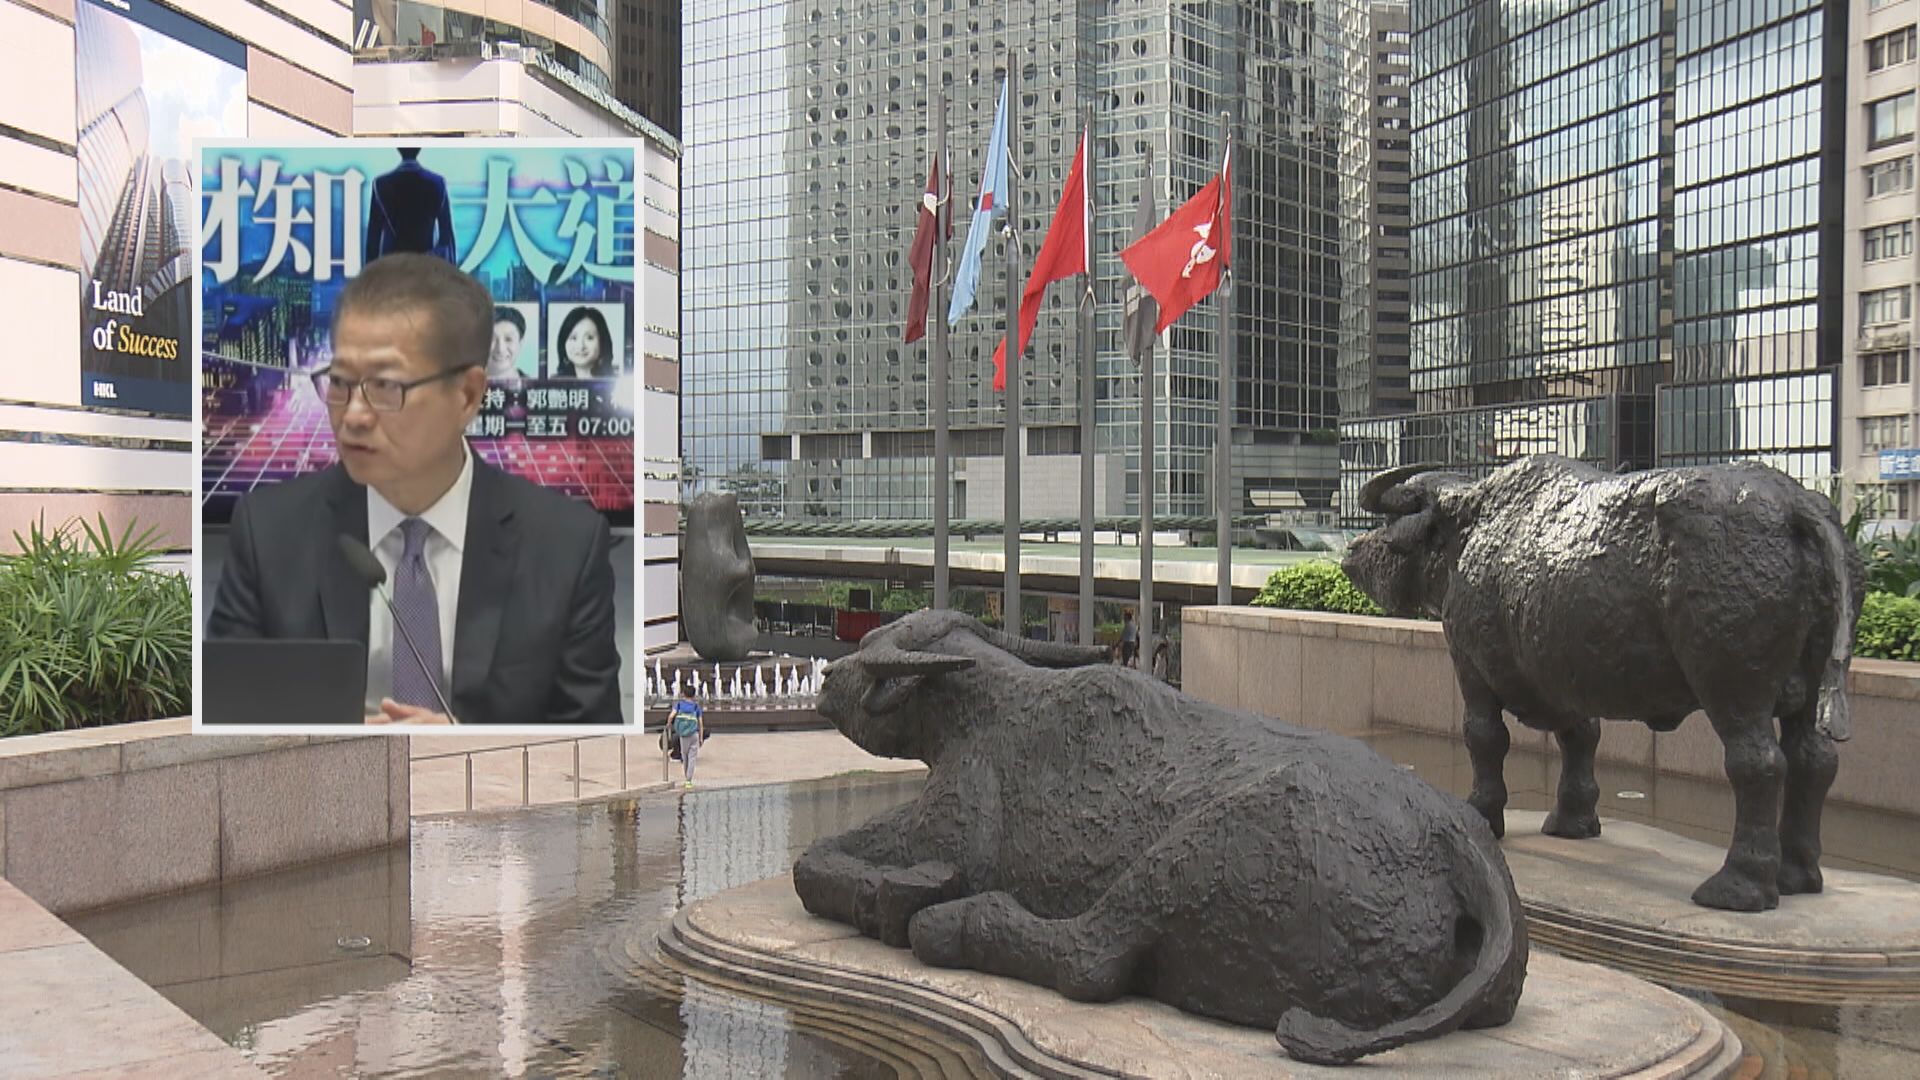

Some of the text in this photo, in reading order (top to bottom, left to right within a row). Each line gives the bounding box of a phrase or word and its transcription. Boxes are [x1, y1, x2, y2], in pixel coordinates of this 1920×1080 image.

[93, 279, 144, 316] Land
[93, 319, 178, 360] of Success
[93, 381, 117, 398] HKL
